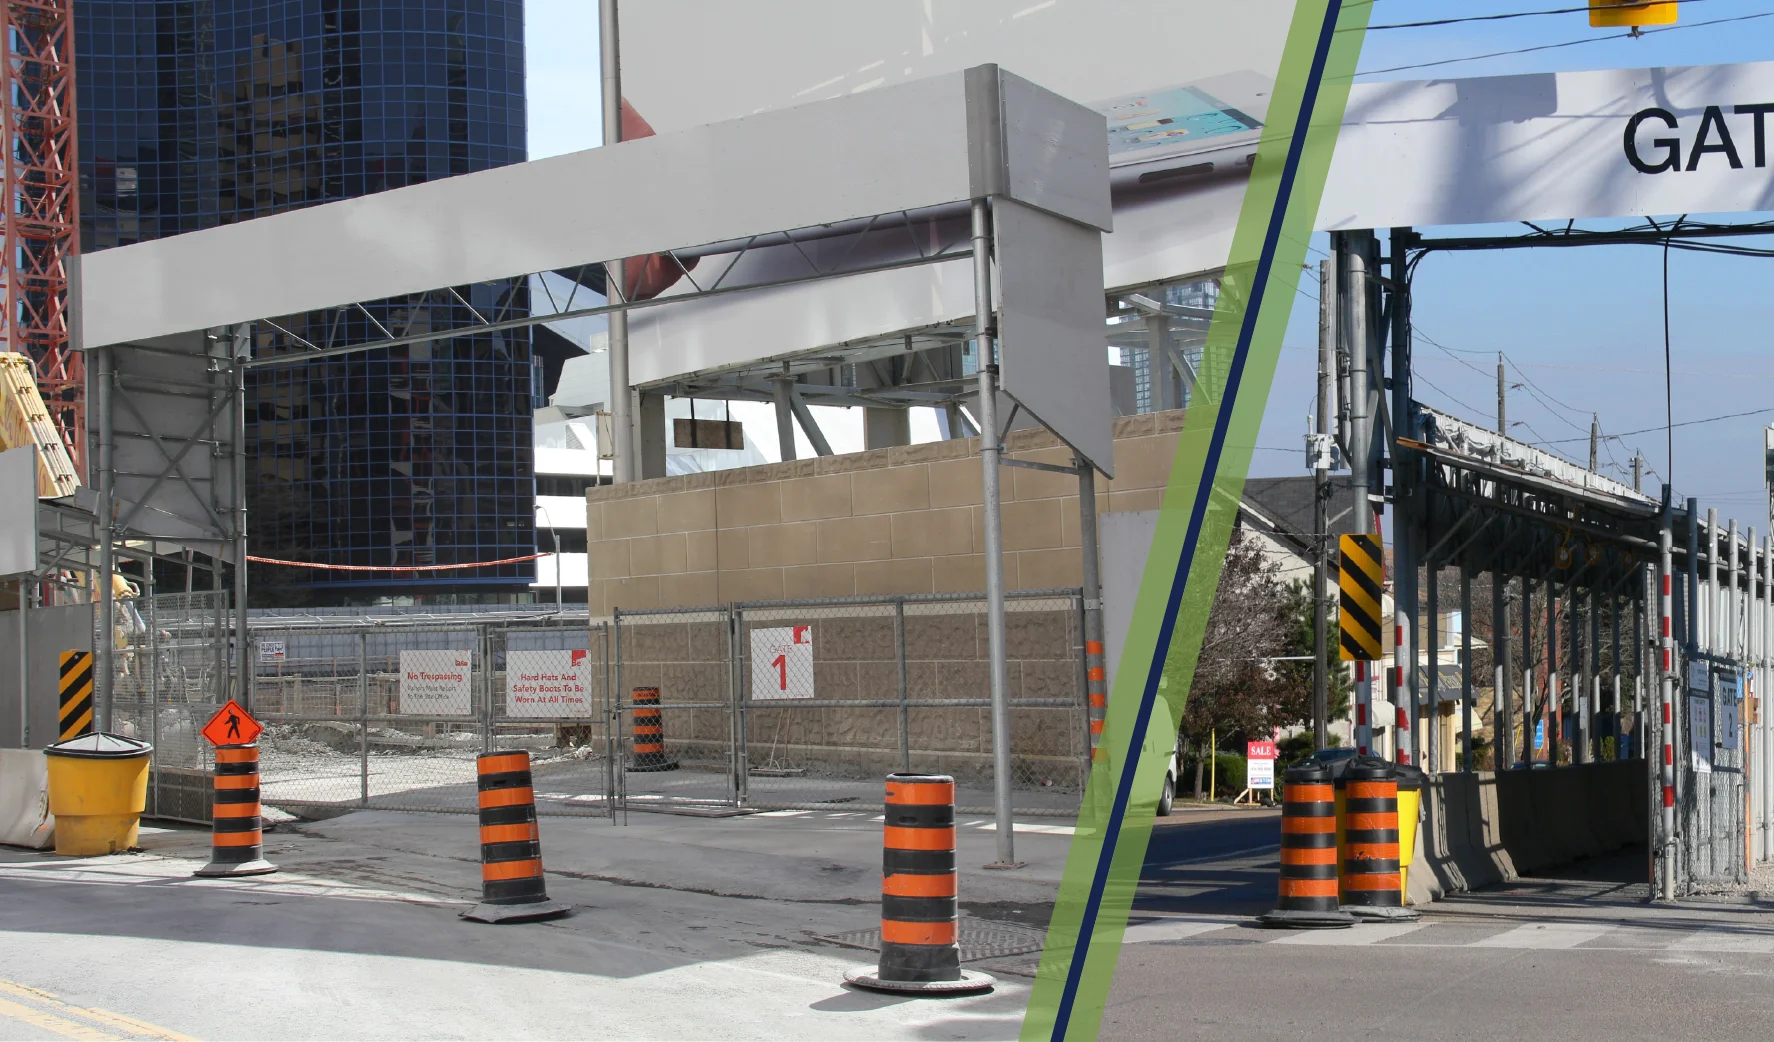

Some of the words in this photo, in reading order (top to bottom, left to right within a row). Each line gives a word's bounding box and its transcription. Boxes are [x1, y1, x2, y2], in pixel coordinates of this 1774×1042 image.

[769, 644, 792, 653] GATE
[407, 672, 419, 680] No
[420, 671, 463, 683] Trespassing
[520, 673, 539, 681] Hard
[541, 673, 559, 681] Hats
[561, 673, 577, 681] And
[771, 655, 787, 690] 1
[513, 685, 537, 694] Safety
[1722, 686, 1738, 707] GATE
[1728, 712, 1733, 738] 2
[1251, 746, 1272, 756] SALE
